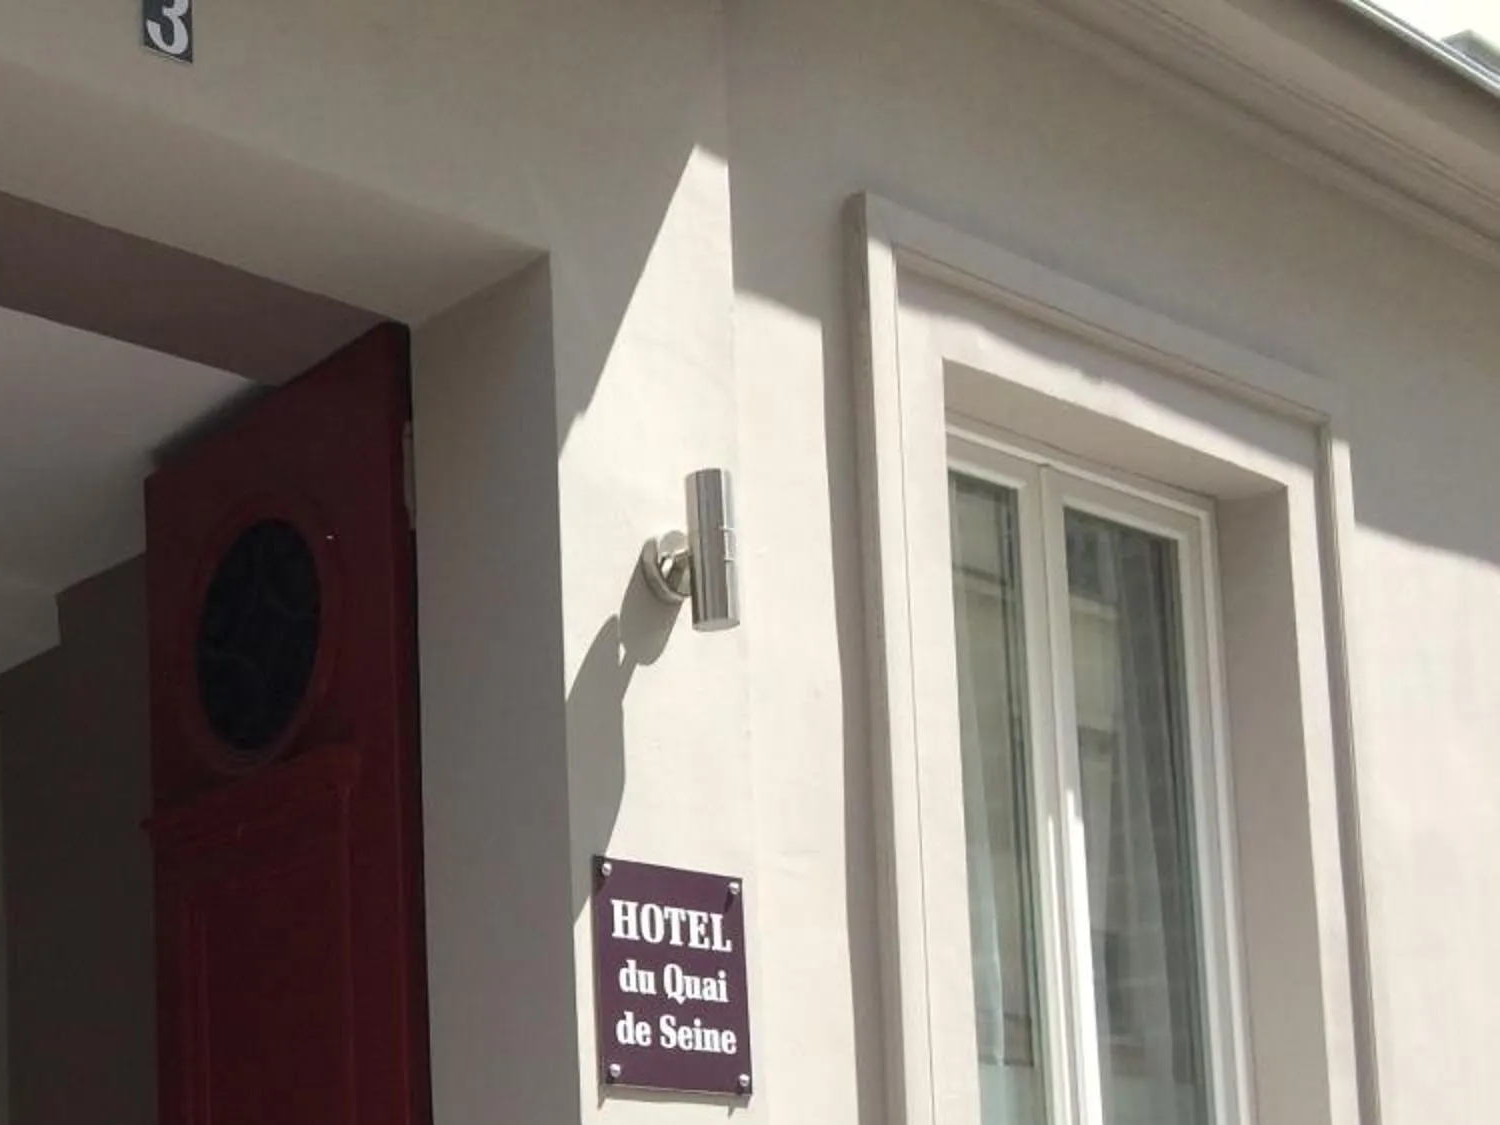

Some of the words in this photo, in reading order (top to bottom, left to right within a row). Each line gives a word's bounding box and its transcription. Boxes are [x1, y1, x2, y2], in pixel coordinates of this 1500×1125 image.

[146, 0, 188, 55] 3
[610, 899, 732, 953] HOTEL
[618, 959, 656, 995] du
[663, 963, 729, 1005] Quai
[615, 1010, 652, 1047] de
[659, 1014, 737, 1055] Seine
